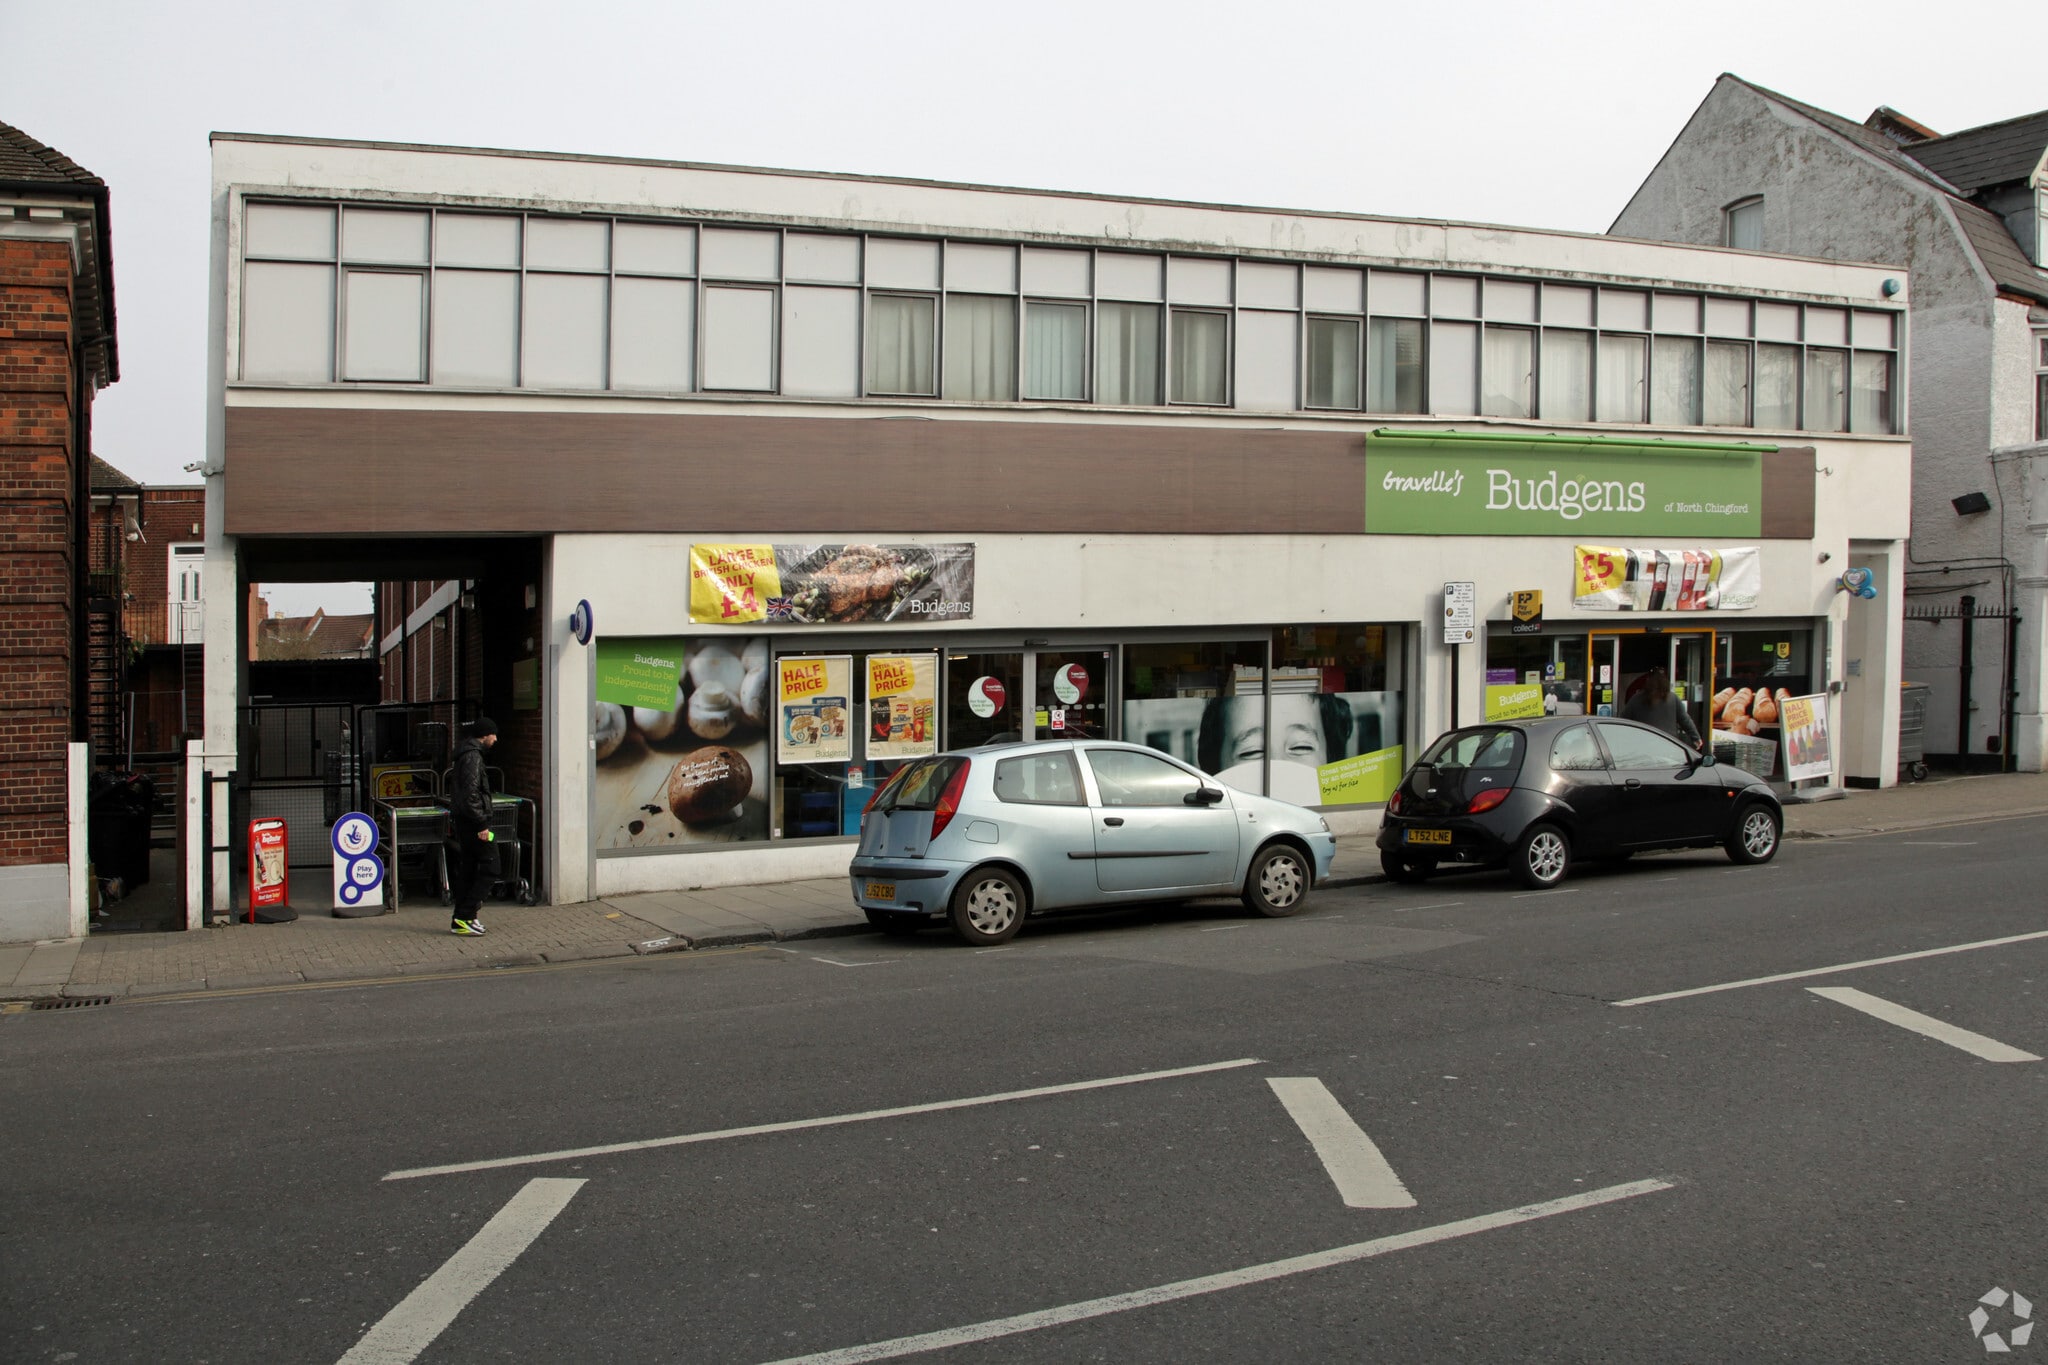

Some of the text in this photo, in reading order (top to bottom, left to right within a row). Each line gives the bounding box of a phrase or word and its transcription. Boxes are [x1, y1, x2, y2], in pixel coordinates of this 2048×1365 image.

[1382, 469, 1749, 520] Gravelle's Budgens of North Chingford
[708, 549, 754, 567] LARGE
[732, 557, 773, 572] CHICKEN
[1582, 553, 1614, 582] £5
[1590, 582, 1608, 592] EACH
[721, 587, 759, 618] £4
[1721, 593, 1758, 605] Budgens
[910, 599, 970, 616] Budgens
[623, 664, 674, 681] Proud to be
[784, 664, 821, 683] HALF
[873, 666, 906, 682] HALF
[604, 675, 673, 695] independently
[786, 678, 823, 695] PRICE
[875, 677, 908, 693] PRICE
[1499, 688, 1538, 706] Budgens
[1503, 710, 1510, 718] to
[1510, 707, 1518, 716] be
[1518, 704, 1532, 714] part
[1532, 702, 1539, 710] of
[1785, 701, 1806, 714] HALF
[1787, 709, 1808, 722] PRICE
[1789, 717, 1809, 730] WINES
[815, 750, 848, 759] Budgens
[1321, 751, 1397, 777] Great value is measured
[1321, 764, 1379, 785] by an empty plate
[382, 778, 401, 788] ONLY
[385, 784, 402, 798] £4
[1322, 786, 1332, 796] try
[1338, 781, 1348, 792] for
[1348, 779, 1359, 788] size
[1409, 831, 1450, 842] LT52 LNE
[356, 872, 374, 880] here
[357, 865, 373, 873] Play
